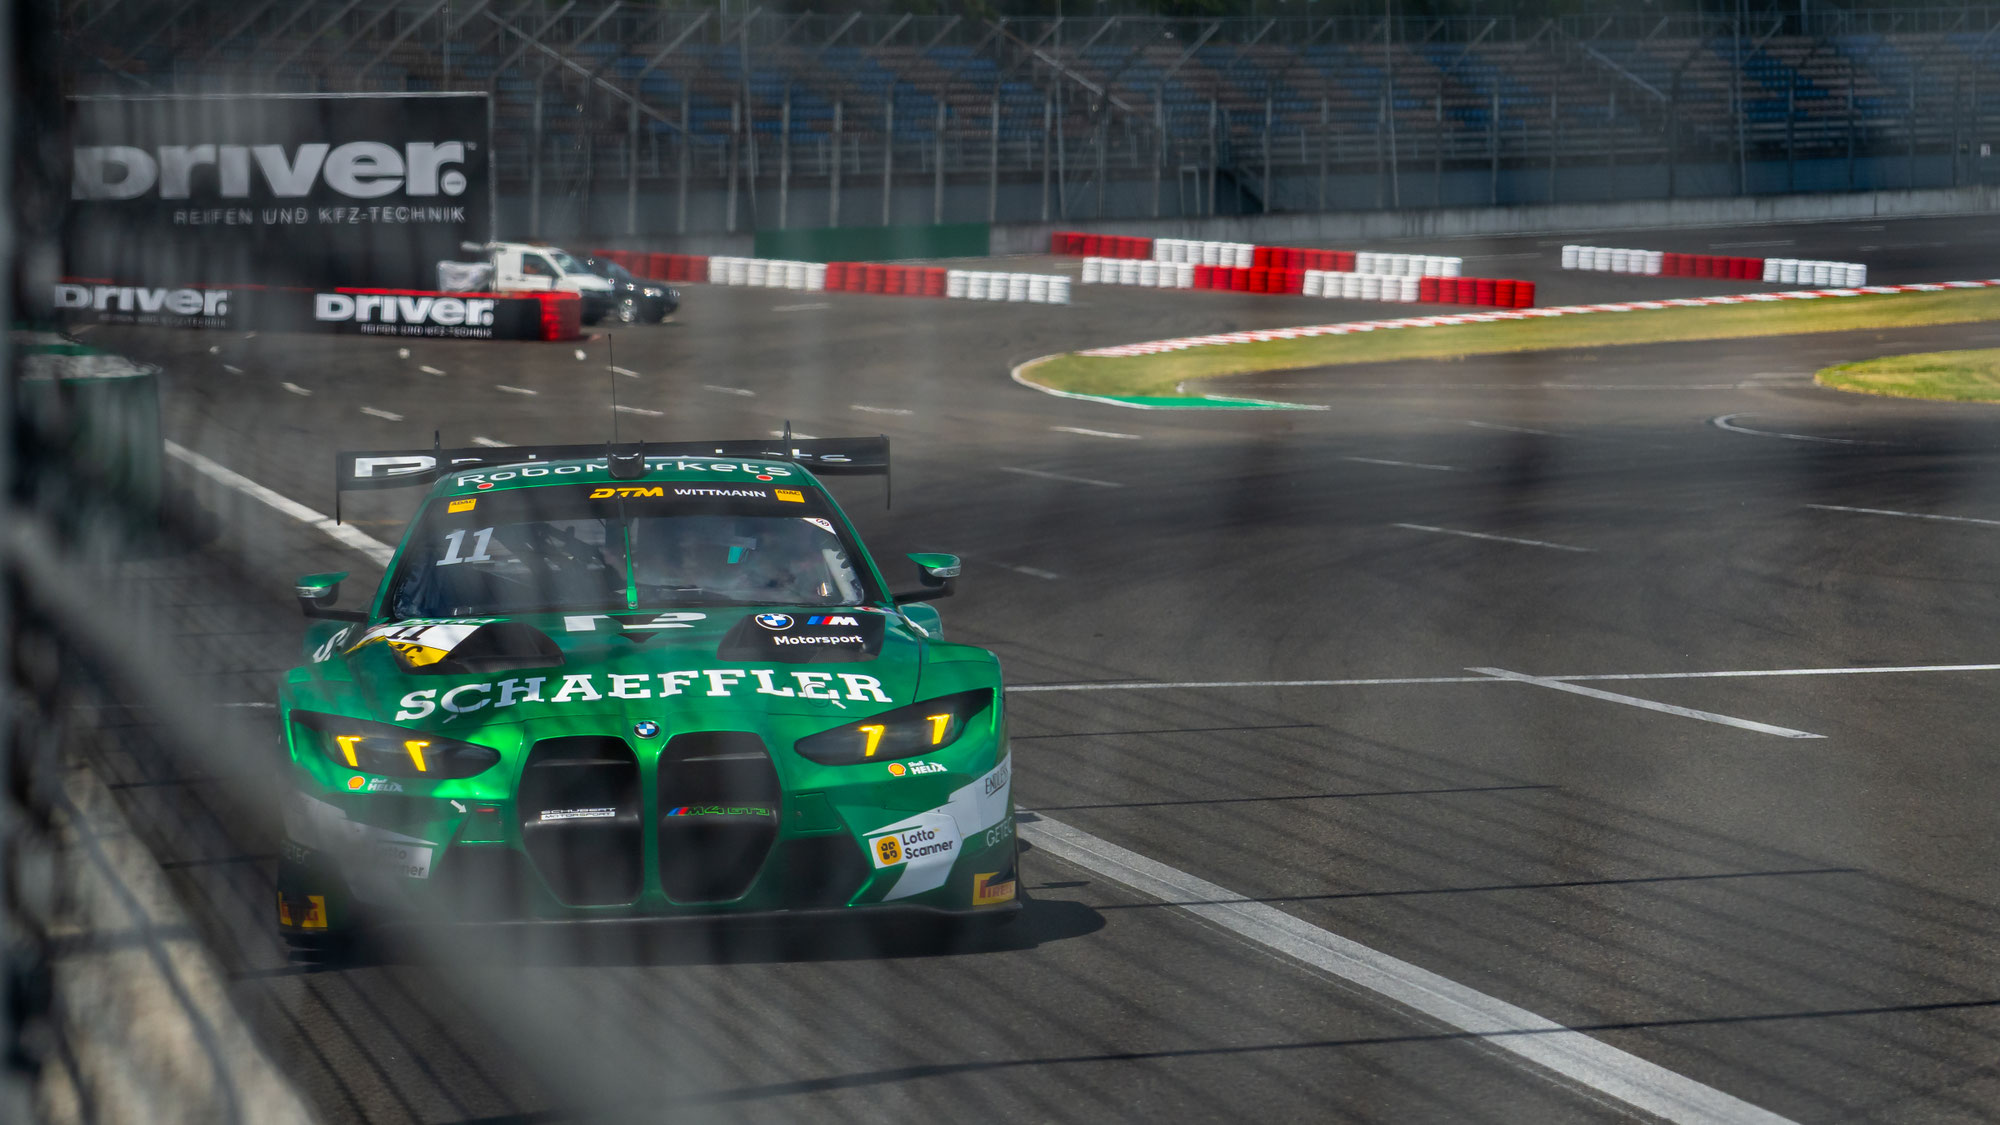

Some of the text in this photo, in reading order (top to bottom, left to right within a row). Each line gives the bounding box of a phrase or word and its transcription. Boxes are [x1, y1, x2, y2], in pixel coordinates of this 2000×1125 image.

[174, 206, 465, 225] REIFEN UND KFZ-TECHNIK
[457, 460, 793, 487] RoboMrkets
[589, 487, 767, 499] DTM WITTMANN
[435, 527, 494, 566] 11
[773, 635, 864, 645] Motorsport
[395, 669, 893, 721] SCHAEFFLER
[910, 762, 948, 774] HELIX
[902, 828, 935, 846] Lotto
[904, 840, 954, 860] Scanner
